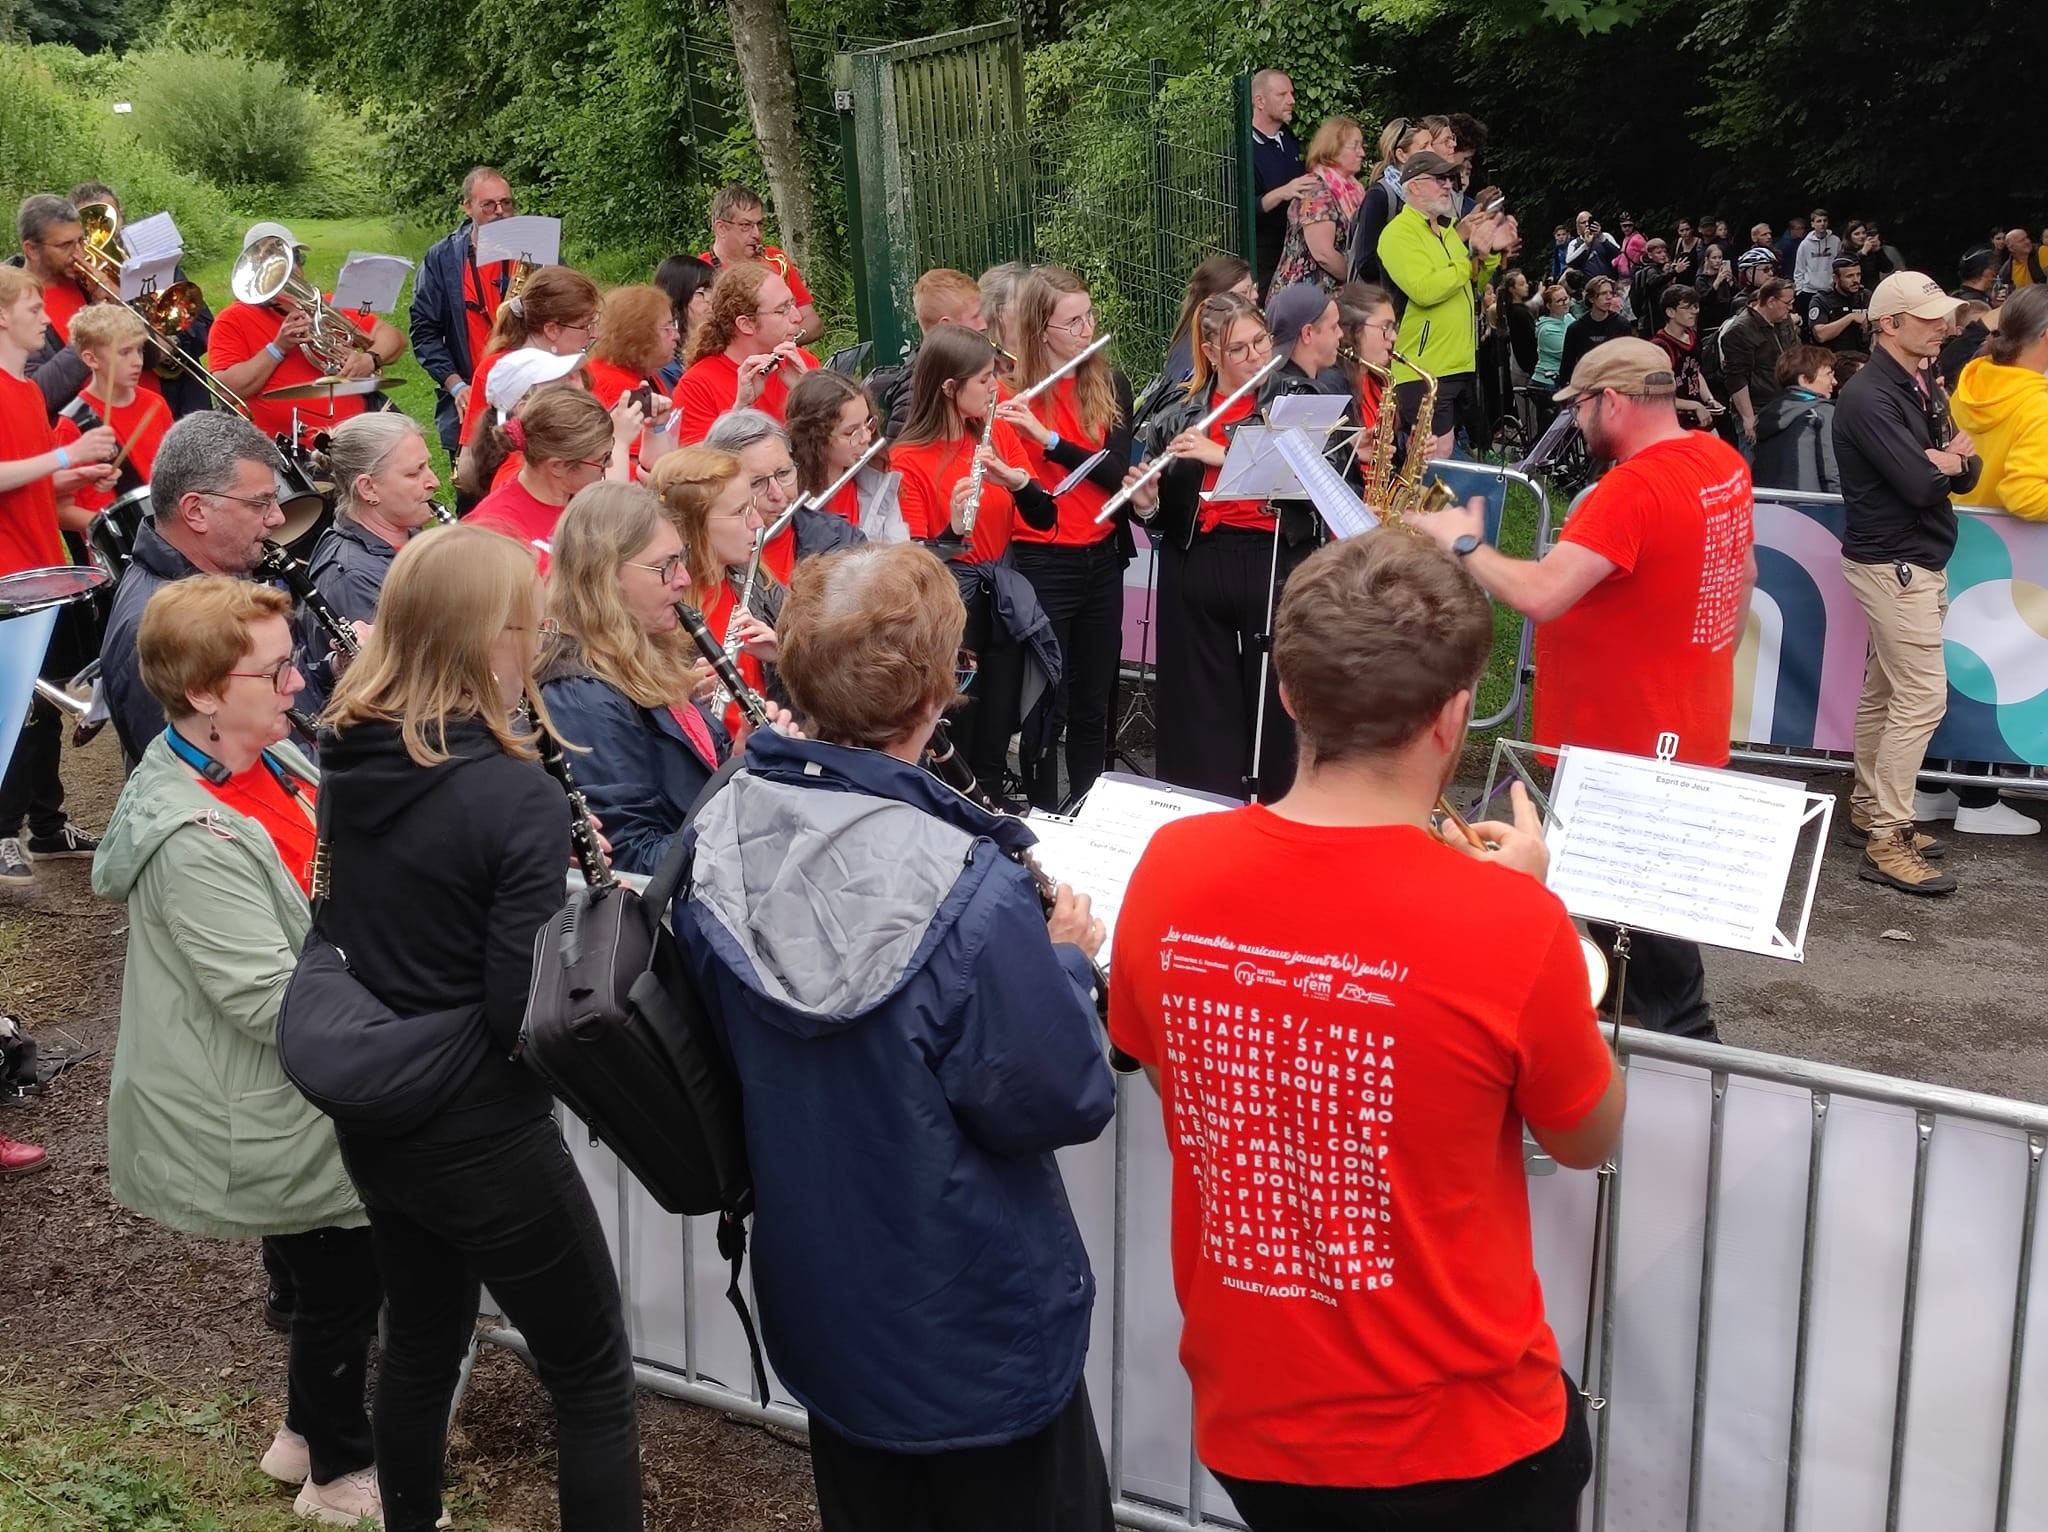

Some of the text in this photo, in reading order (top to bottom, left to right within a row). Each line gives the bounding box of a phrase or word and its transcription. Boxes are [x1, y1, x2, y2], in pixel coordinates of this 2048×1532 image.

[1655, 776, 1679, 787] Esprit
[1691, 783, 1710, 792] Jeux
[1161, 925, 1181, 942] Les
[1181, 930, 1236, 951] ensembles
[1237, 943, 1290, 960] musicaux
[1285, 950, 1331, 965] jouent
[1310, 1289, 1338, 1307] 2024
